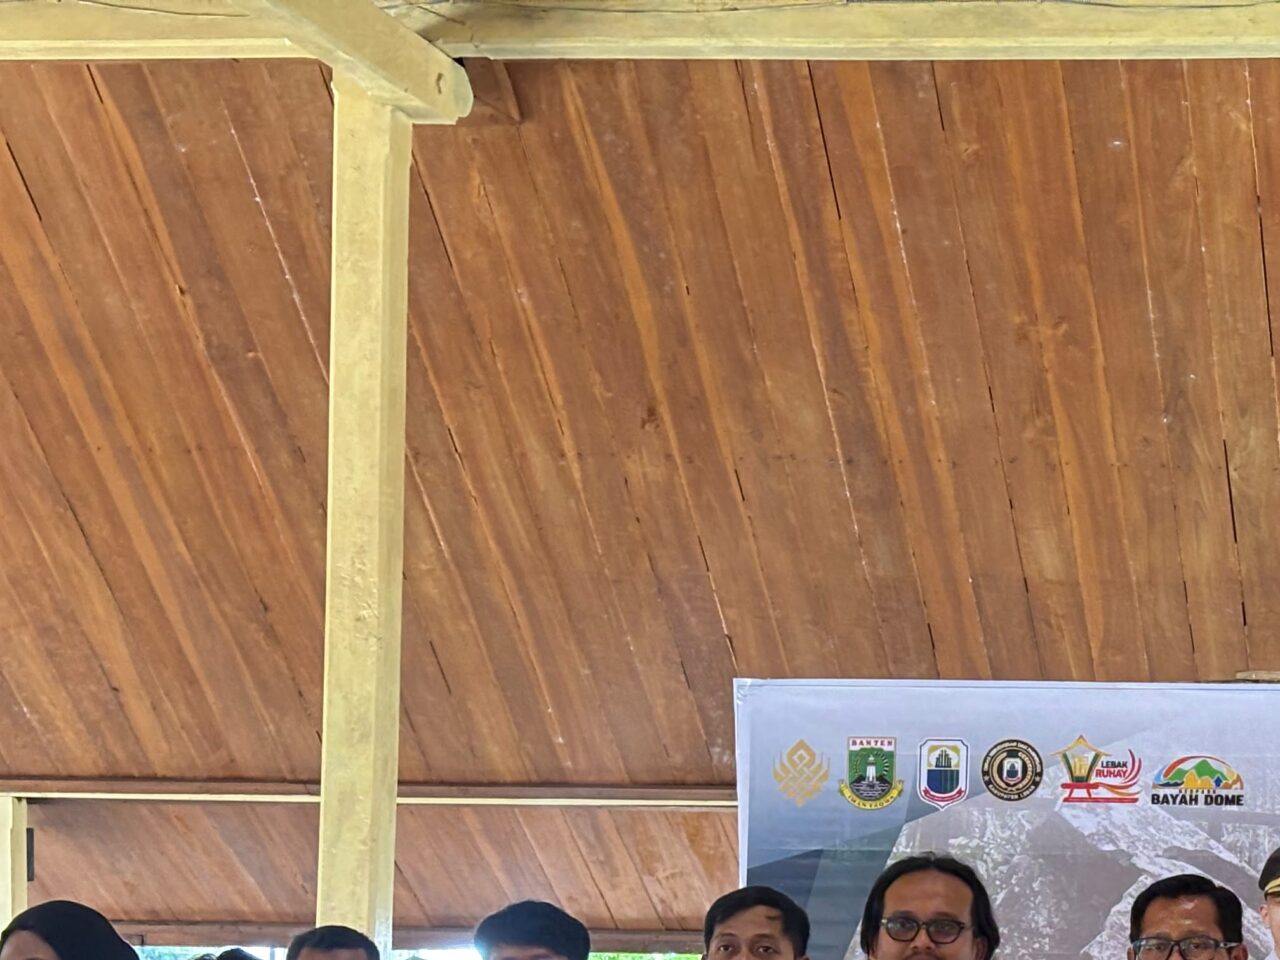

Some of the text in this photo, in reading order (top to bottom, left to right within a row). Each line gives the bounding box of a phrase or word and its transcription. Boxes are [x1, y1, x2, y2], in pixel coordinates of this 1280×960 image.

[851, 739, 893, 747] BANTEN
[1101, 760, 1128, 769] LEBAK
[1095, 769, 1128, 778] RUHAY
[1151, 793, 1244, 806] BAYAH DOME
